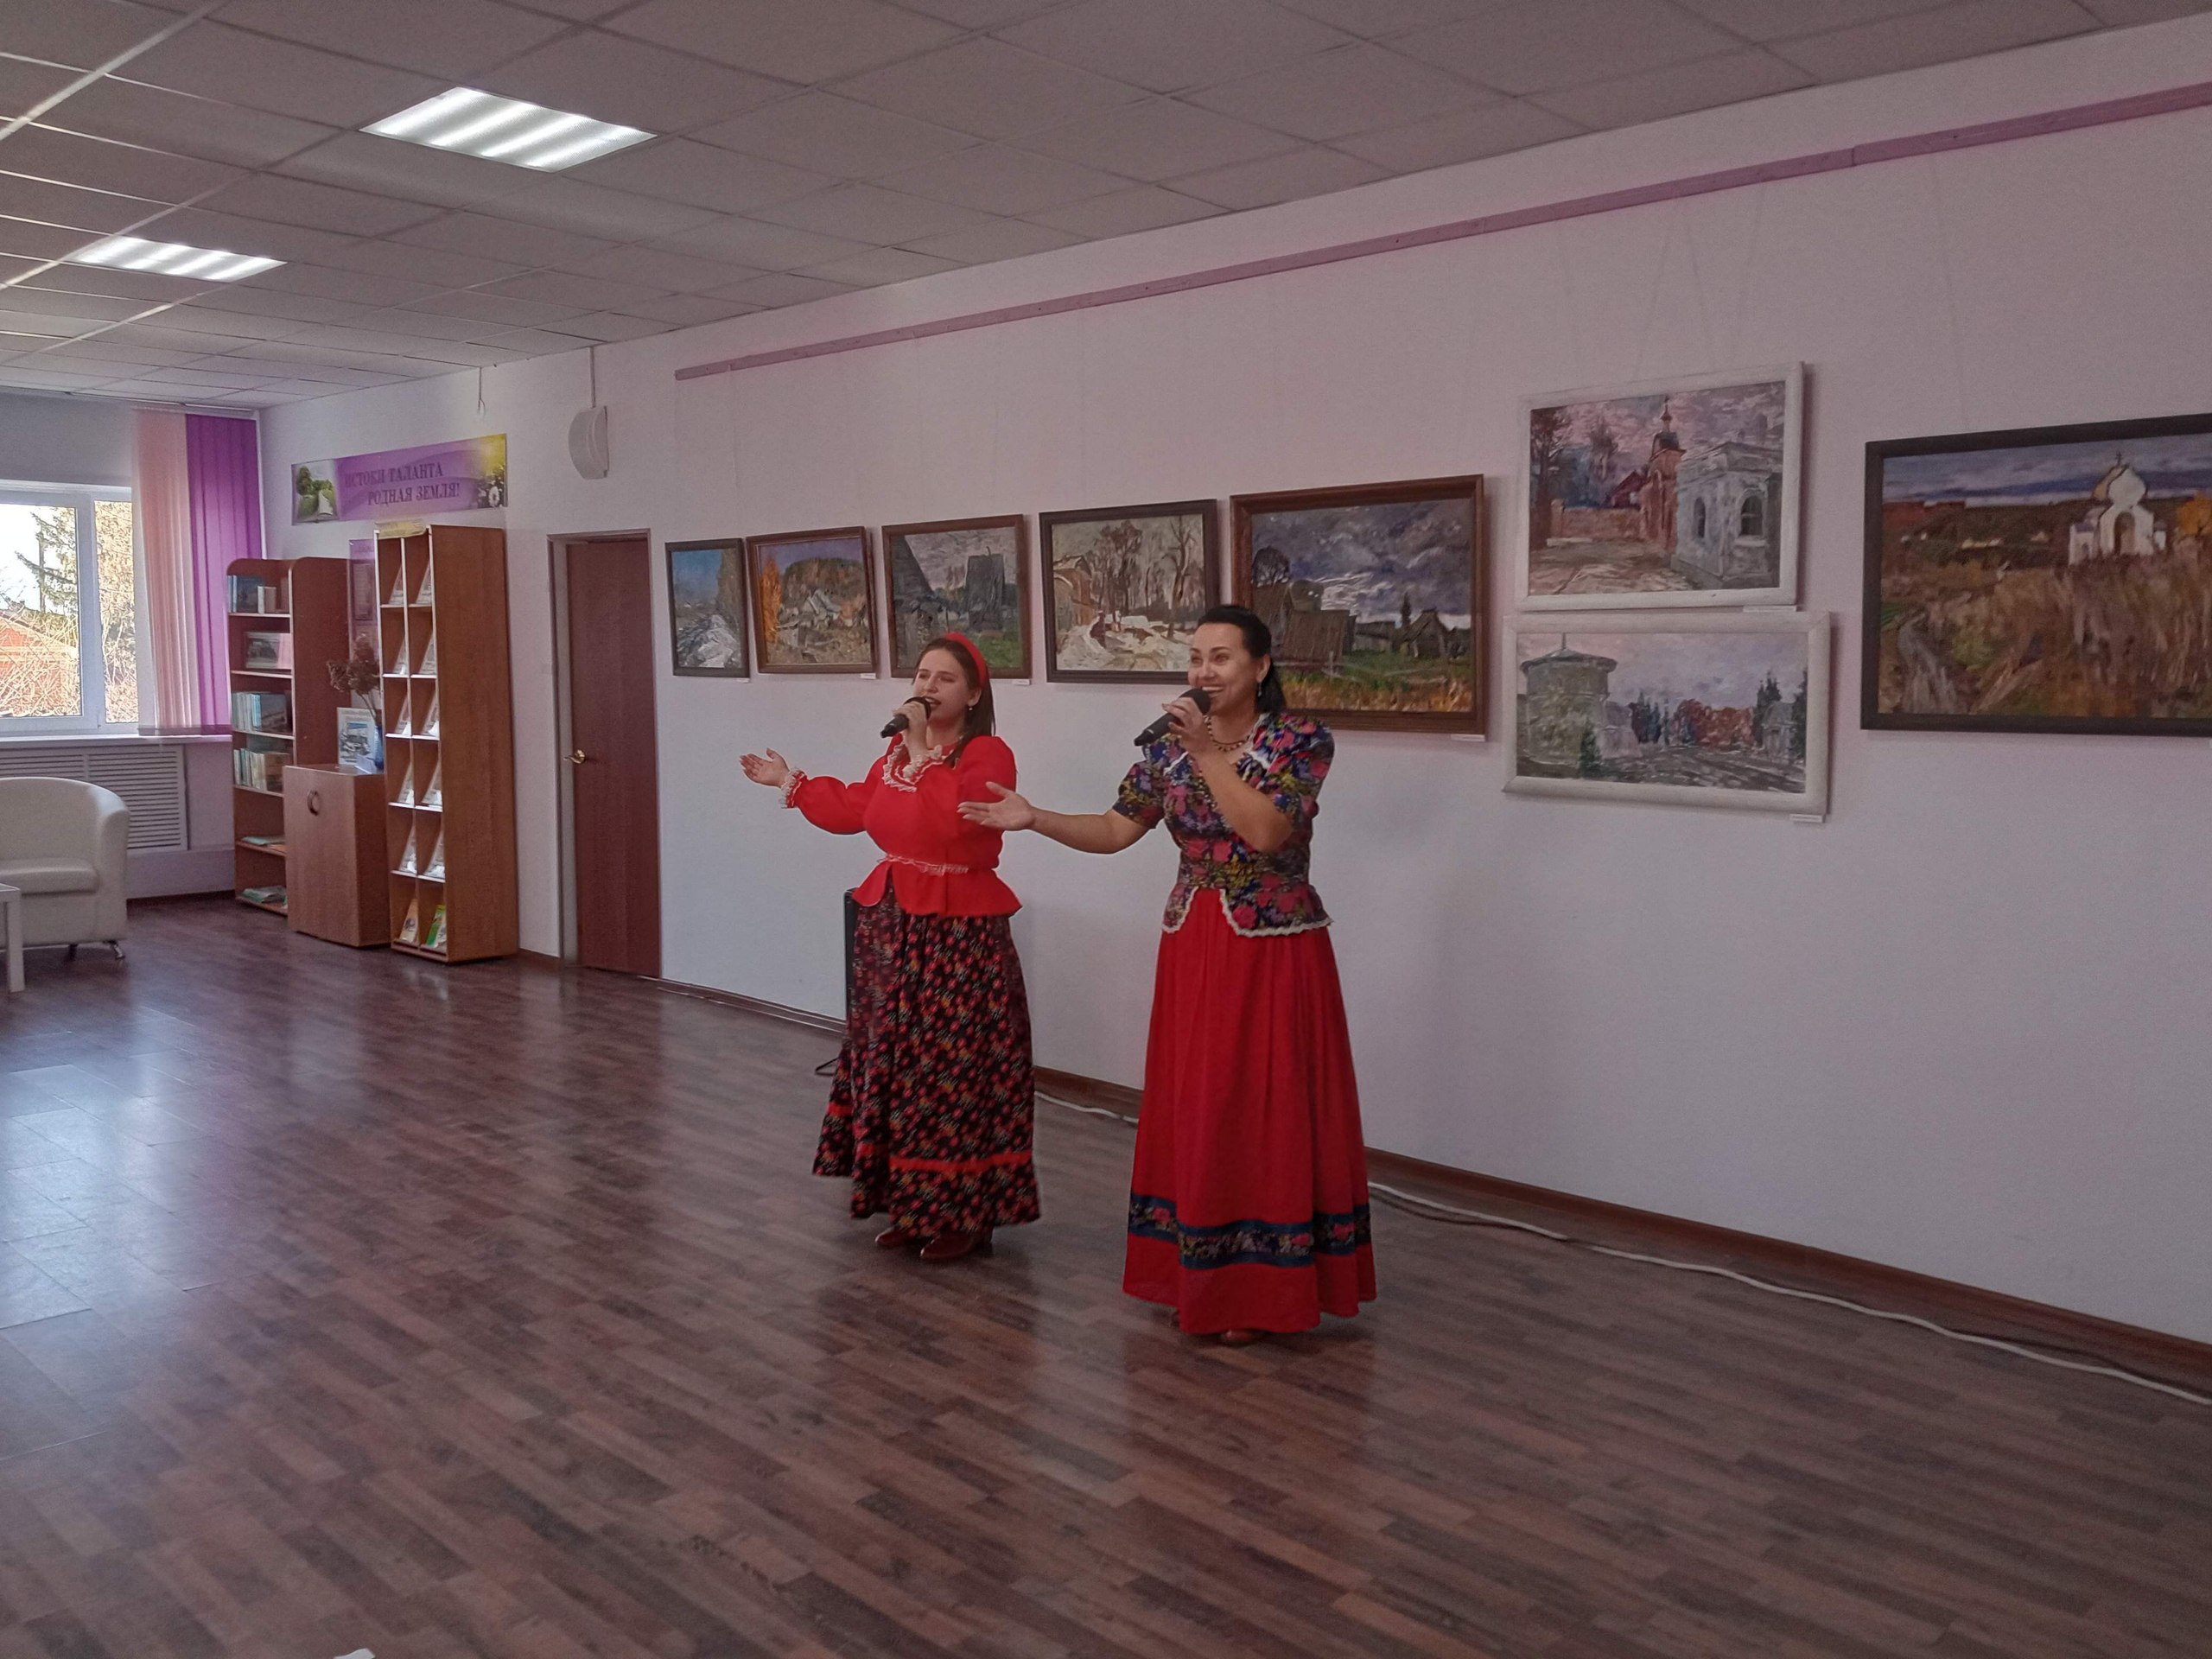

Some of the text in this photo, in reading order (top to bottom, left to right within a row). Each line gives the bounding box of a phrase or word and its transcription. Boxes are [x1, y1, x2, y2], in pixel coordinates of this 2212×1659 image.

[344, 463, 443, 488] ИСТОКИ ТАЛАНТА
[367, 482, 460, 506] РОДНАЯ ЗЕМЛЯ!
